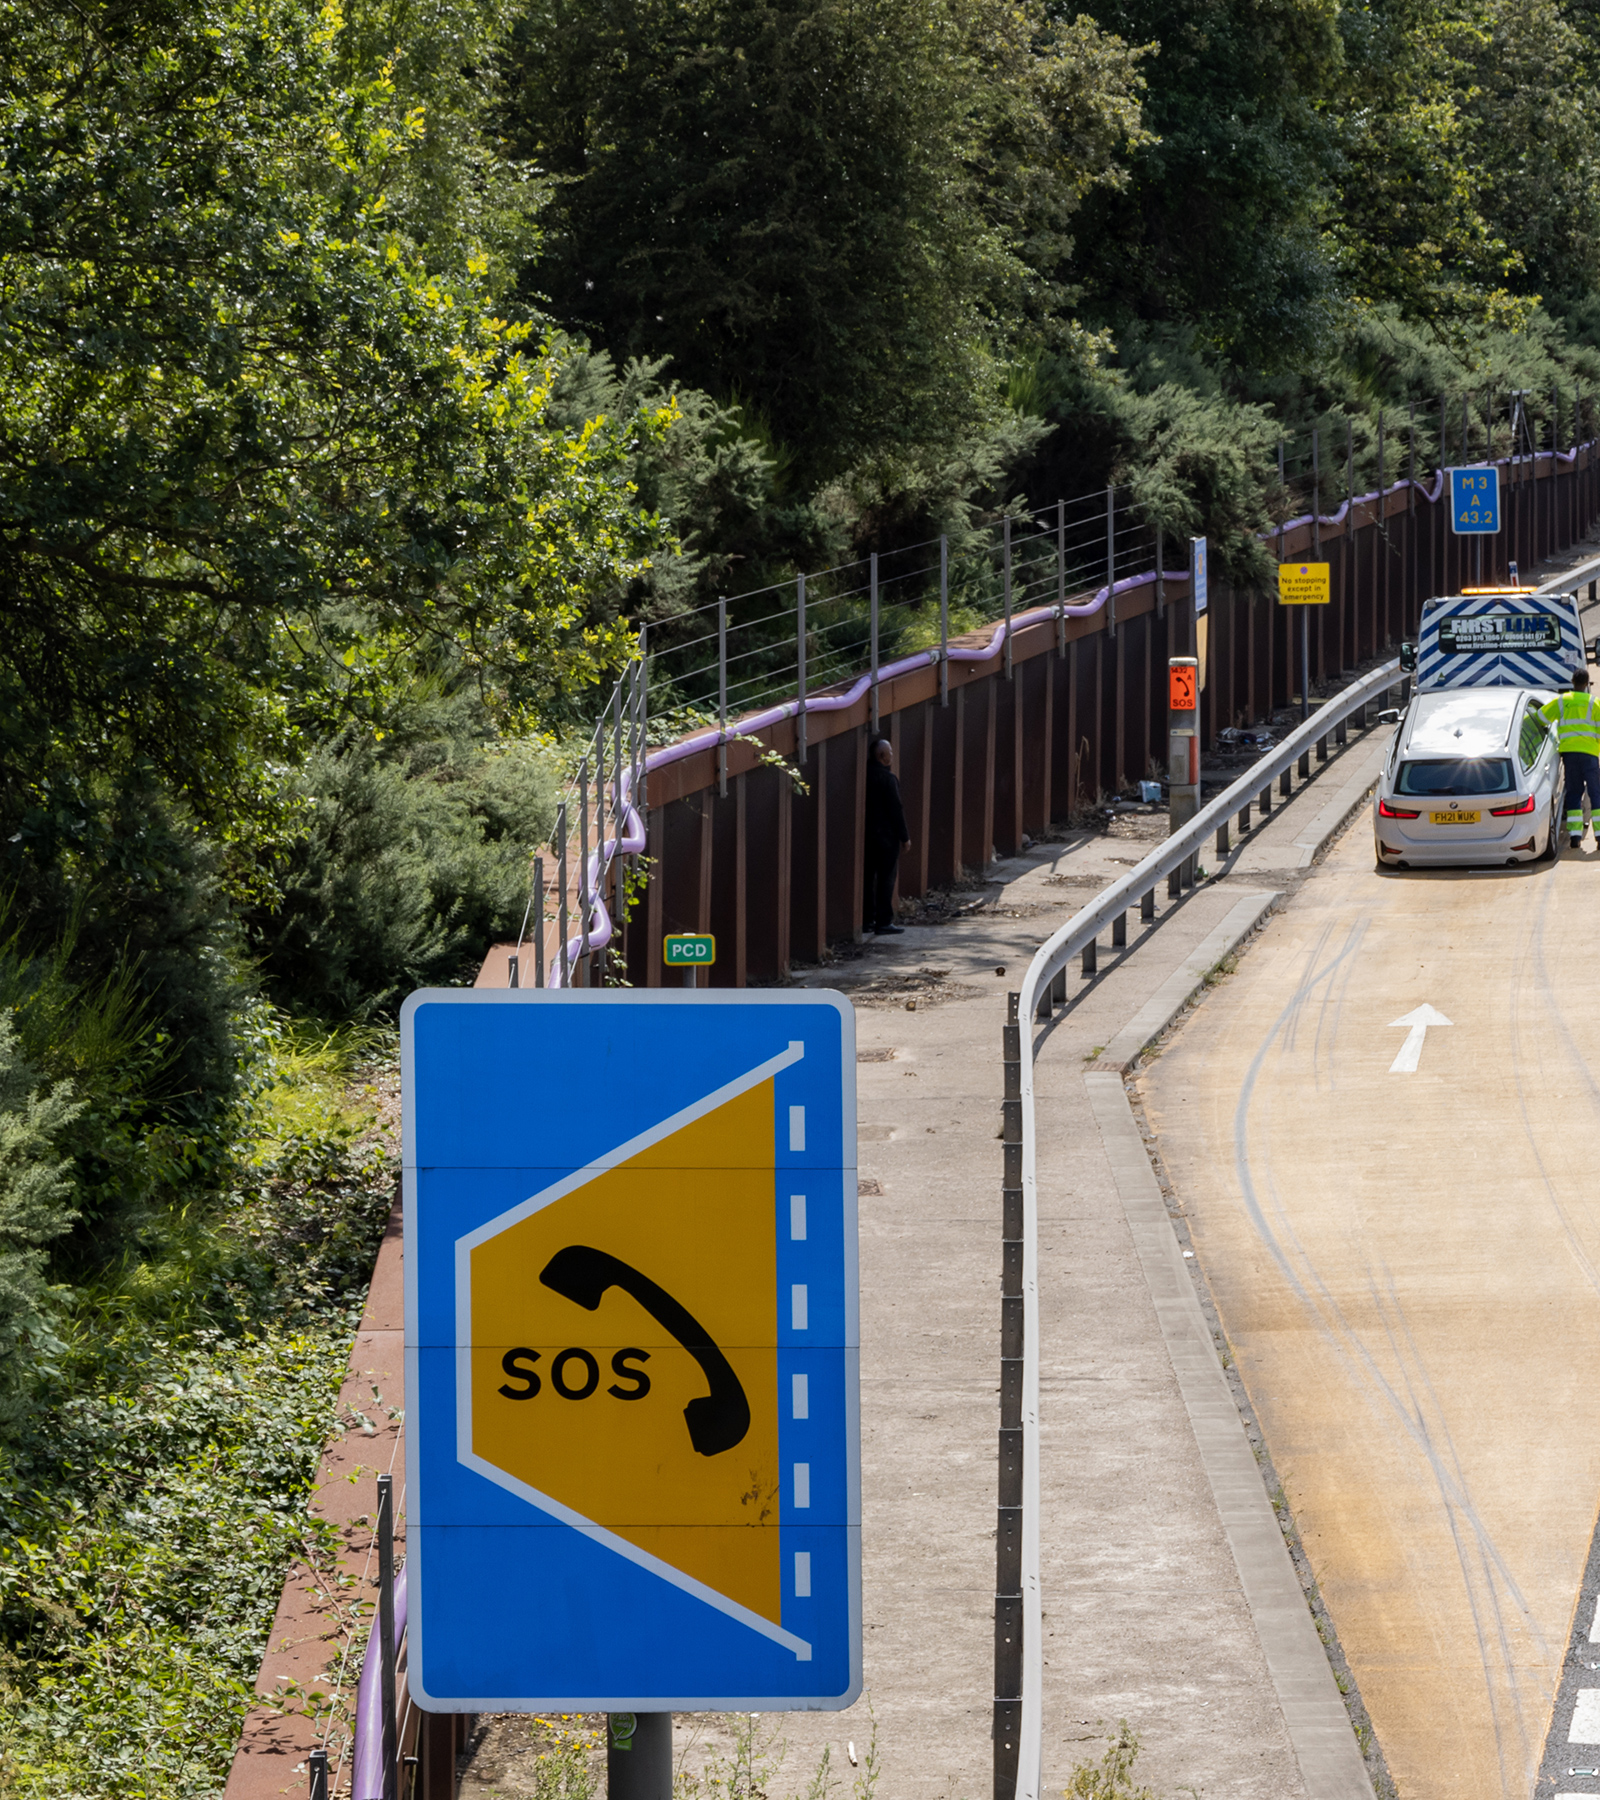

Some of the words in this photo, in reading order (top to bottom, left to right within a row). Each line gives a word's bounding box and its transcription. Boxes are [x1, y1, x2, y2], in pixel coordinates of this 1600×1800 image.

[1462, 477, 1474, 489] M
[1479, 476, 1487, 489] 3
[1470, 494, 1480, 506] A
[1459, 510, 1493, 523] 43.2
[1294, 577, 1327, 585] stopping
[1451, 618, 1549, 633] FIRSTLINE
[1172, 699, 1193, 707] SOS
[1435, 813, 1456, 821] FH21
[672, 943, 707, 957] PCD
[497, 1347, 651, 1401] SOS
